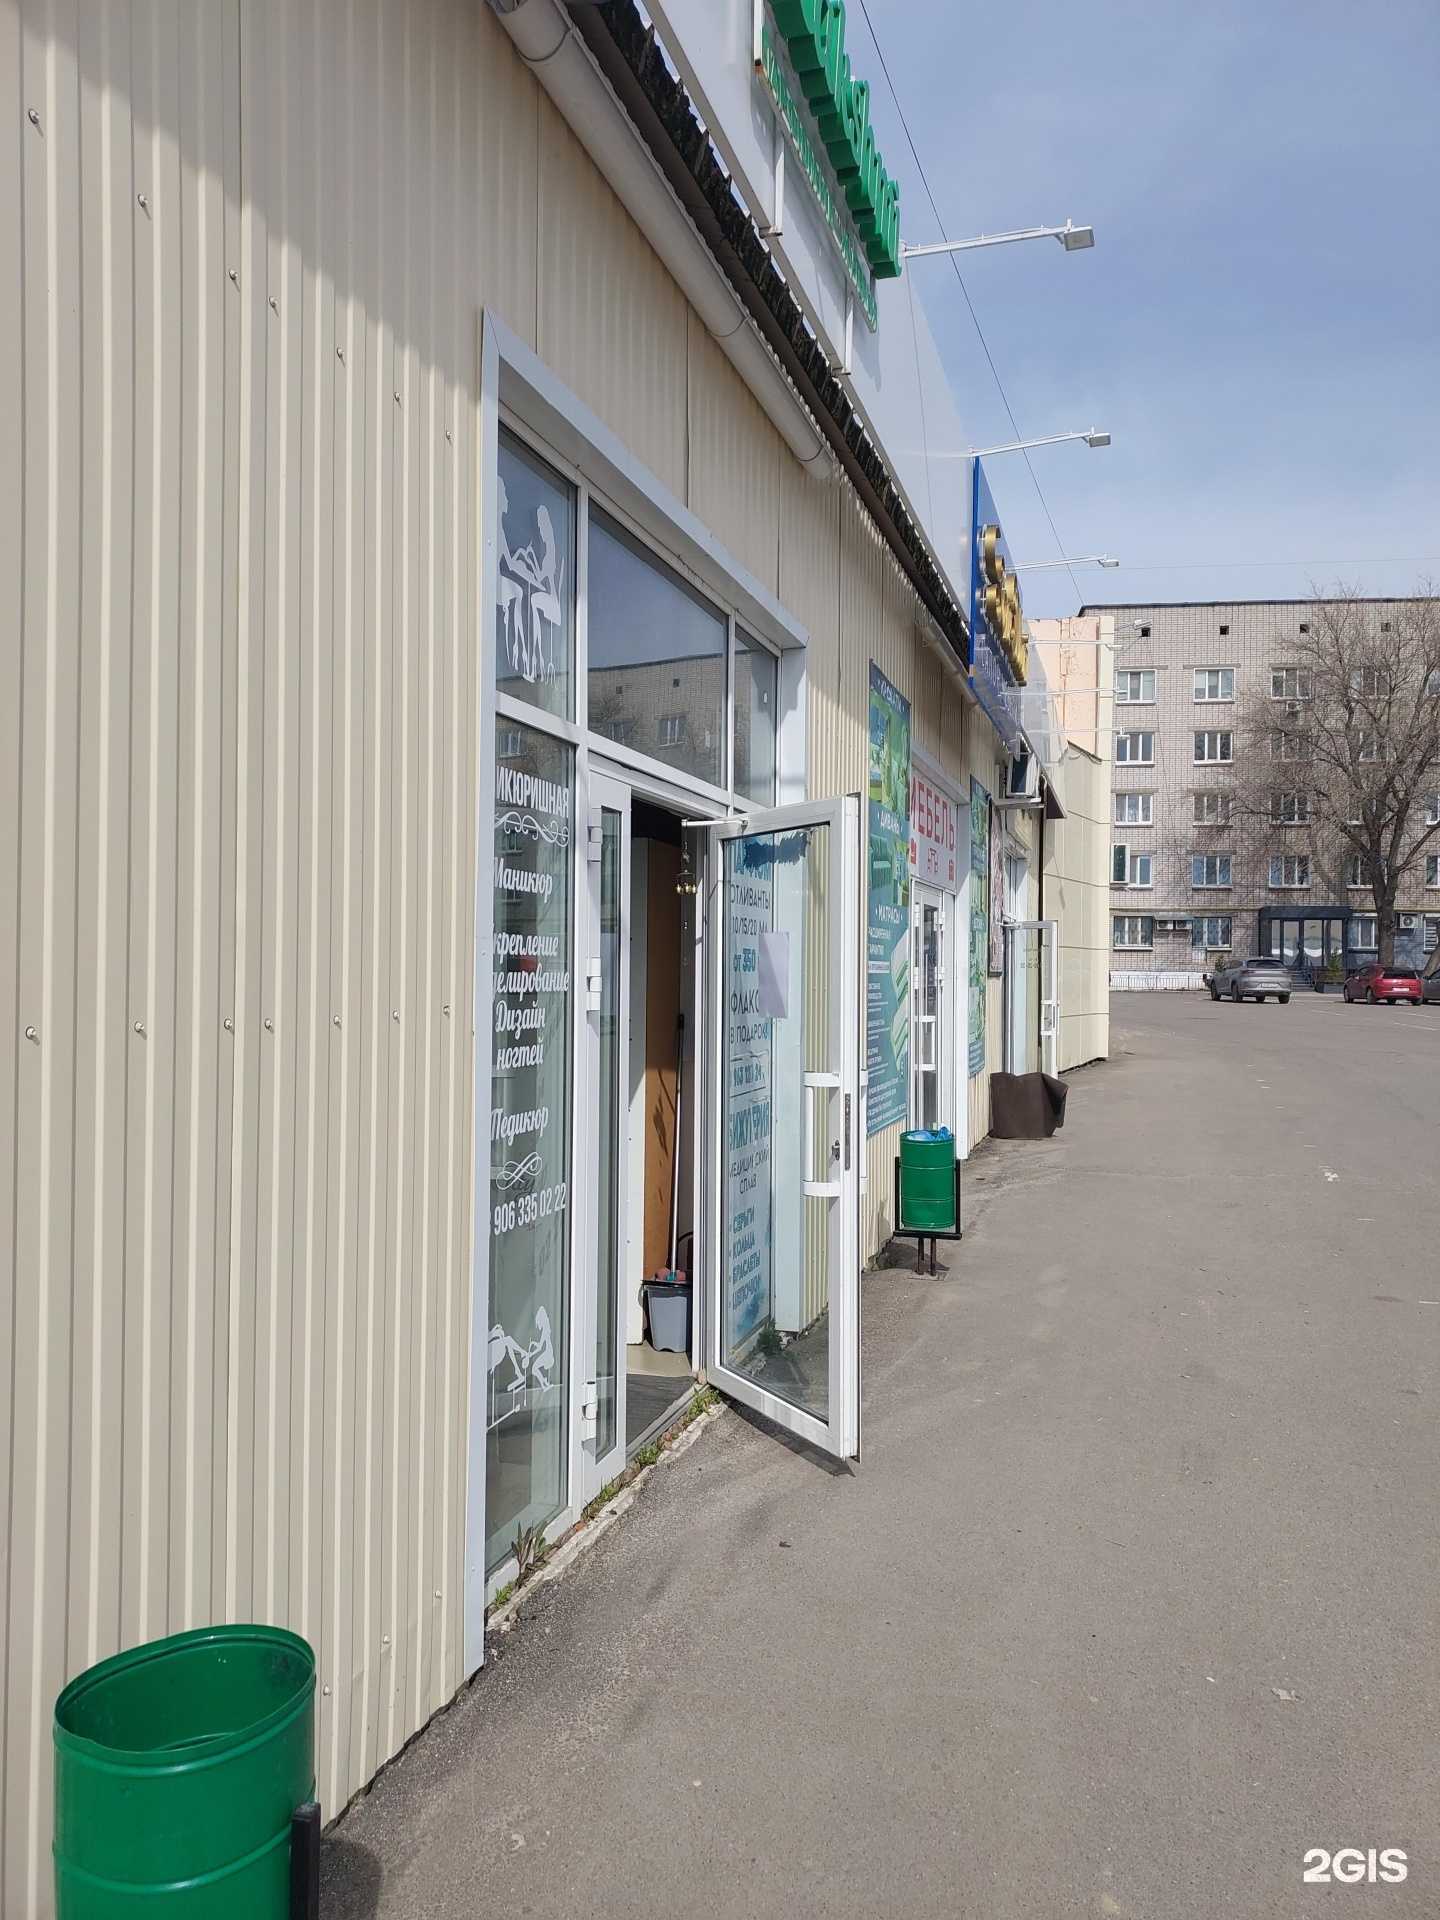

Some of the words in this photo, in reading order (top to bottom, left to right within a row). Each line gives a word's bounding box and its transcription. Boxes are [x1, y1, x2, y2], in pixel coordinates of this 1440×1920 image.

[496, 765, 569, 818] ИКЮРИШНАЯ
[493, 932, 559, 964] крепление
[495, 997, 546, 1040] Дизайн
[496, 1034, 544, 1071] ногтей
[491, 1106, 549, 1146] Педикюр
[494, 1200, 515, 1236] 906
[518, 1192, 538, 1226] 335
[540, 1187, 552, 1217] 02
[555, 1182, 566, 1212] 22
